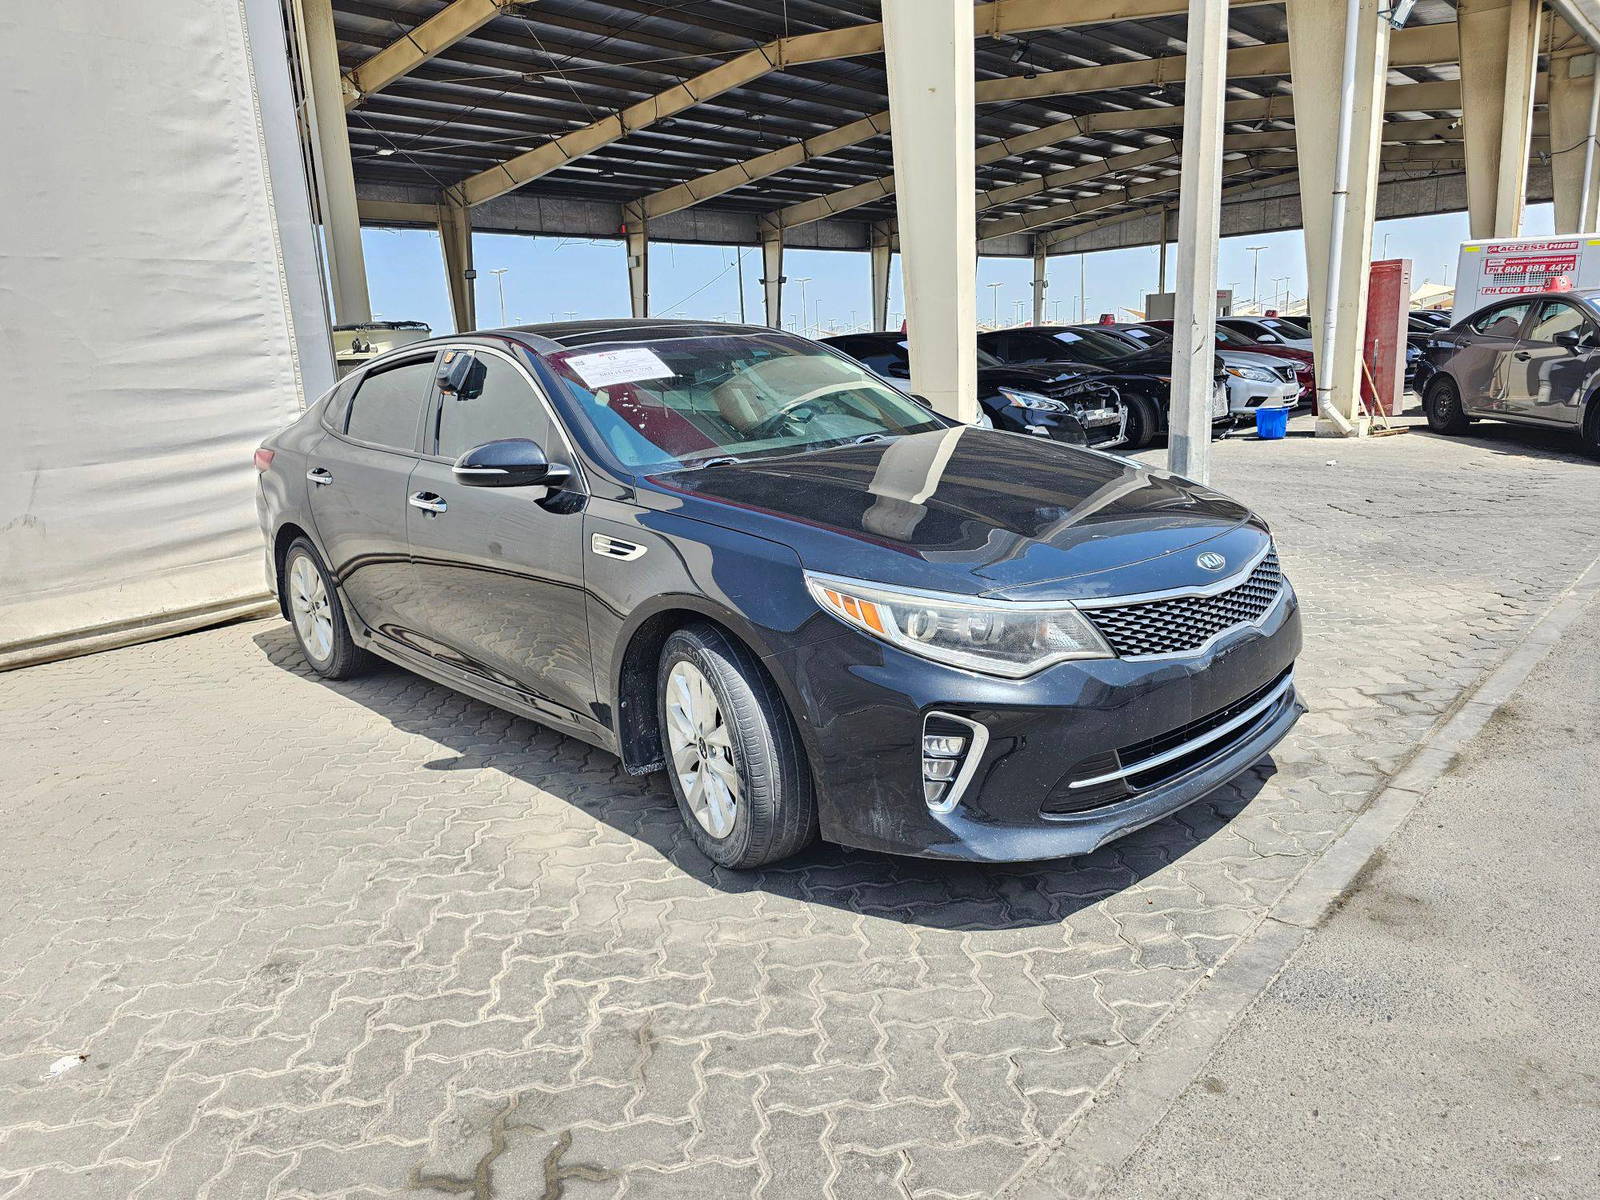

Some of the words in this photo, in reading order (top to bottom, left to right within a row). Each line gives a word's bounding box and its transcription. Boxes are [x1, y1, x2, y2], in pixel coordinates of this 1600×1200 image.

[1499, 244, 1548, 254] ACCESS
[1549, 241, 1577, 250] HIRE
[1504, 265, 1523, 273] 800
[1525, 264, 1545, 272] 888
[1548, 262, 1574, 271] 4473
[1199, 553, 1224, 569] KIA
